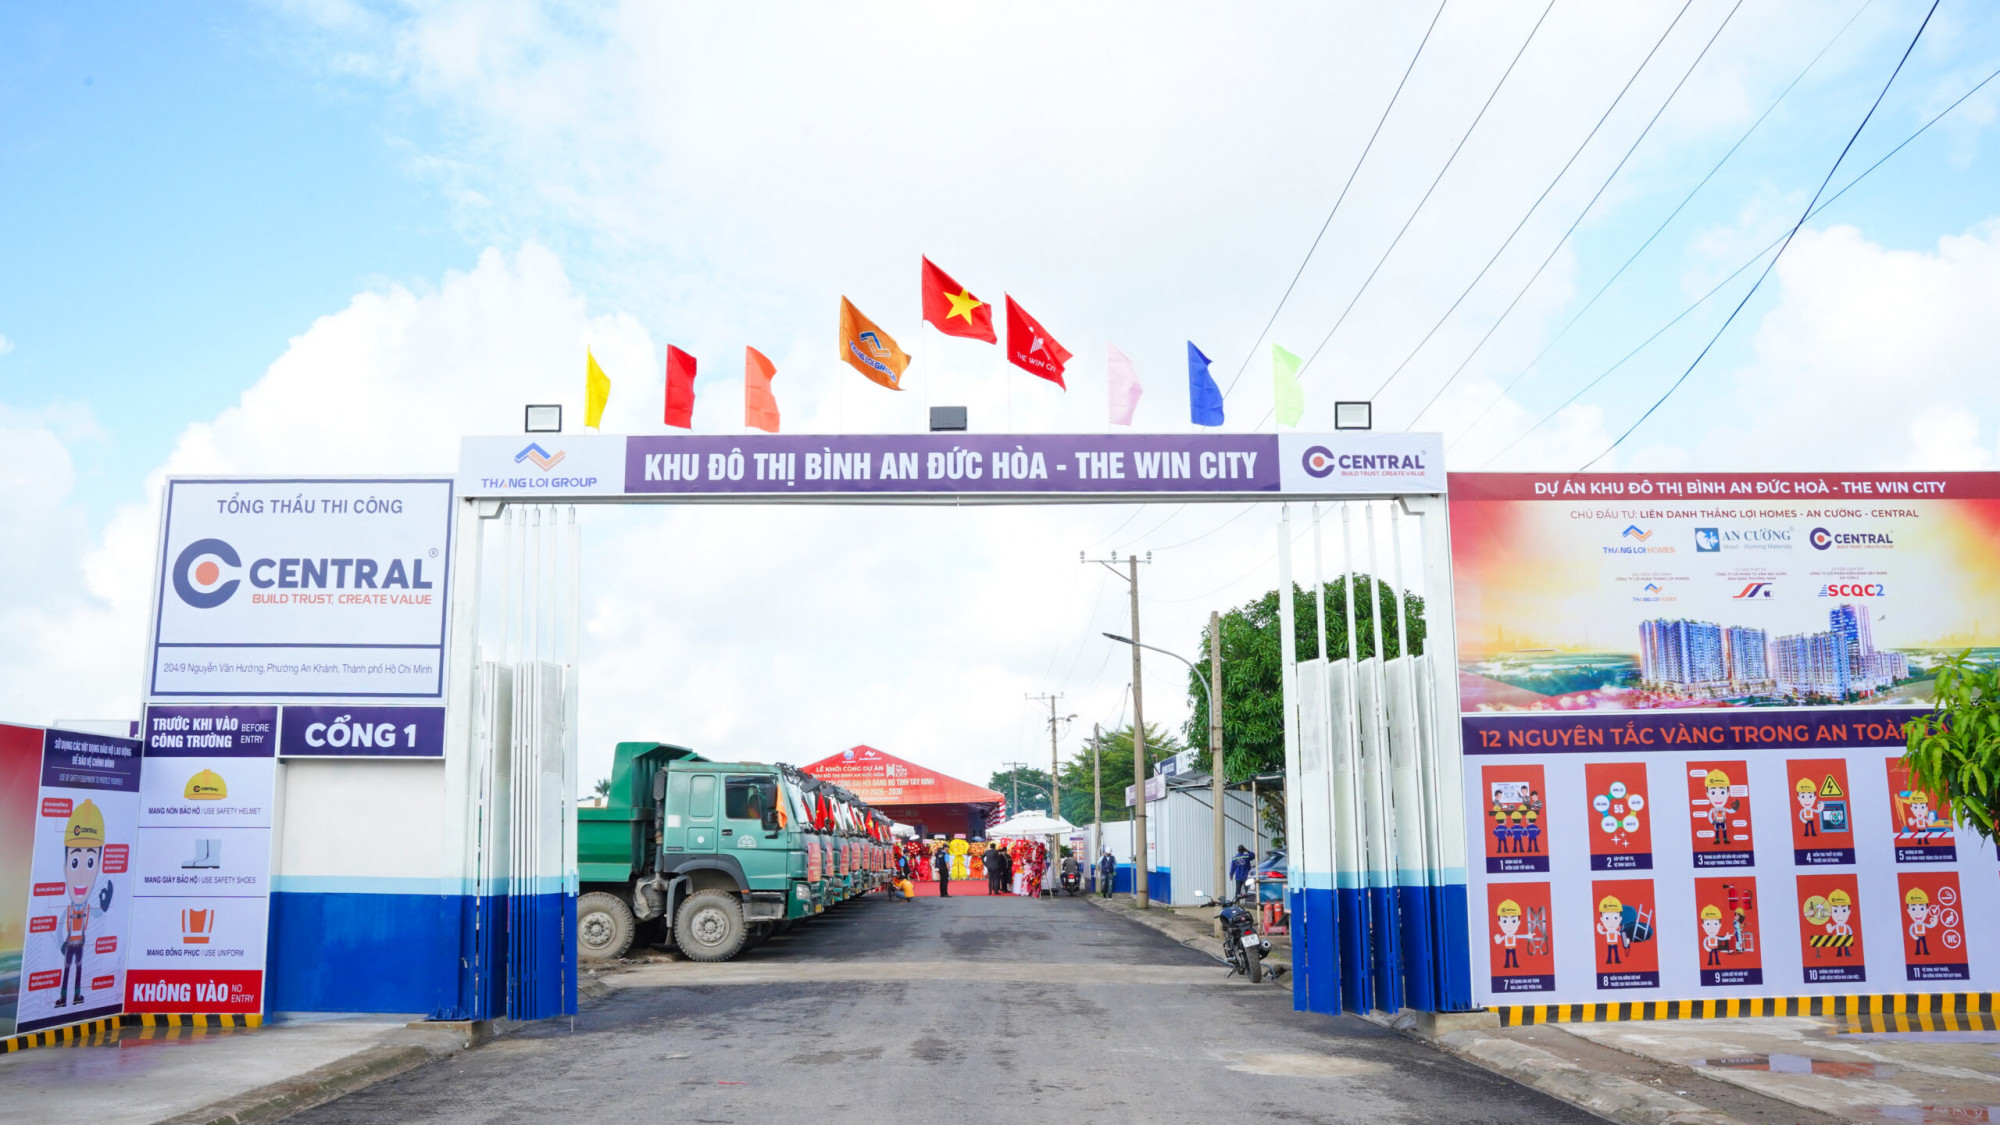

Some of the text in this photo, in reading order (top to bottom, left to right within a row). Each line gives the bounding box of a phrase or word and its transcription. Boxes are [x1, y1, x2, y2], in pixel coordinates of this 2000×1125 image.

[1029, 357, 1045, 368] WIN
[644, 452, 700, 481] KHU
[707, 448, 745, 481] ĐÔ
[753, 452, 796, 486] THỊ
[805, 447, 871, 481] BÌNH
[879, 452, 919, 480] AN
[927, 446, 983, 480] ĐỨC
[992, 446, 1048, 480] HÒA
[1075, 451, 1125, 479] THE
[1133, 451, 1191, 479] WIN
[1199, 451, 1258, 479] CITY
[1338, 454, 1425, 470] CENTRAL
[481, 477, 597, 488] THANG LOI GROUP
[1535, 480, 1559, 497] DỰ
[1562, 479, 1586, 494] ÁN
[1590, 482, 1624, 494] KHU
[1628, 480, 1653, 494] ĐÔ
[1656, 482, 1683, 497] THỊ
[1687, 479, 1726, 494] BÌNH
[1729, 482, 1752, 494] AN
[1756, 479, 1791, 494] ĐỨC
[1794, 478, 1830, 494] HOÀ
[1841, 481, 1873, 493] THE
[1875, 481, 1909, 493] WIN
[1912, 481, 1946, 493] CITY
[217, 493, 403, 514] TỔNG THẦU THI CÔNG
[1571, 508, 1593, 519] CHỦ
[1596, 507, 1619, 519] ĐẦU
[1640, 508, 1664, 519] LIÊN
[1667, 510, 1698, 519] DANH
[1701, 507, 1737, 519] THẮNG
[1740, 509, 1757, 520] LỢI
[1759, 510, 1798, 518] HOMES
[1806, 510, 1821, 518] AN
[1824, 508, 1862, 518] CƯỜNG
[1871, 510, 1919, 518] CENTRAL
[1723, 528, 1791, 541] AN CƯỜNG
[1834, 534, 1894, 544] CENTRAL
[249, 558, 433, 590] CENTRAL
[1828, 584, 1885, 597] SCQC2
[252, 593, 432, 606] BUILD TRUST, CREATE VALUE
[163, 662, 187, 674] 204/9
[187, 661, 218, 676] Nguyễn
[219, 663, 235, 674] Văn
[267, 663, 299, 676] Phường
[300, 663, 313, 674] An
[313, 662, 340, 675] Khánh,
[342, 663, 367, 675] Thành
[368, 662, 383, 677] phố
[384, 662, 397, 675] Hồ
[398, 663, 412, 675] Chí
[413, 663, 433, 675] Minh
[152, 716, 239, 731] TRƯỚC KHI VÀO
[241, 723, 270, 733] BEFORE
[305, 714, 417, 748] CỔNG 1
[1480, 729, 1502, 748] 12
[1507, 723, 1605, 747] NGUYÊN
[1609, 720, 1655, 746] TẮC
[1664, 719, 1725, 745] VÀNG
[1729, 724, 1810, 744] TRONG
[1815, 723, 1848, 743] AN
[152, 732, 233, 748] CÔNG TRƯỜNG
[240, 734, 265, 744] ENTRY
[148, 805, 261, 815] MANG NÓN BẢO HỘ USE SAFETY HELMET
[1614, 804, 1624, 814] 5S
[1698, 854, 1704, 865] 3
[1806, 852, 1812, 863] 4
[1898, 850, 1905, 860] 5
[1500, 860, 1504, 870] 1
[1606, 857, 1612, 868] 2
[144, 874, 256, 885] MANG GIÀY BẢO HỘ USE SAFETY SHOES
[1946, 935, 1958, 944] WC
[183, 949, 200, 957] PHỤC
[204, 949, 216, 957] USE
[217, 949, 244, 957] UNIFORM
[1714, 972, 1720, 983] 9
[1808, 970, 1818, 980] 10
[1913, 968, 1920, 978] 11
[1504, 980, 1509, 990] 7
[1603, 976, 1609, 987] 8
[133, 979, 229, 1002] KHÔNG VÀO
[231, 984, 243, 993] NO
[231, 994, 254, 1003] ENTRY
